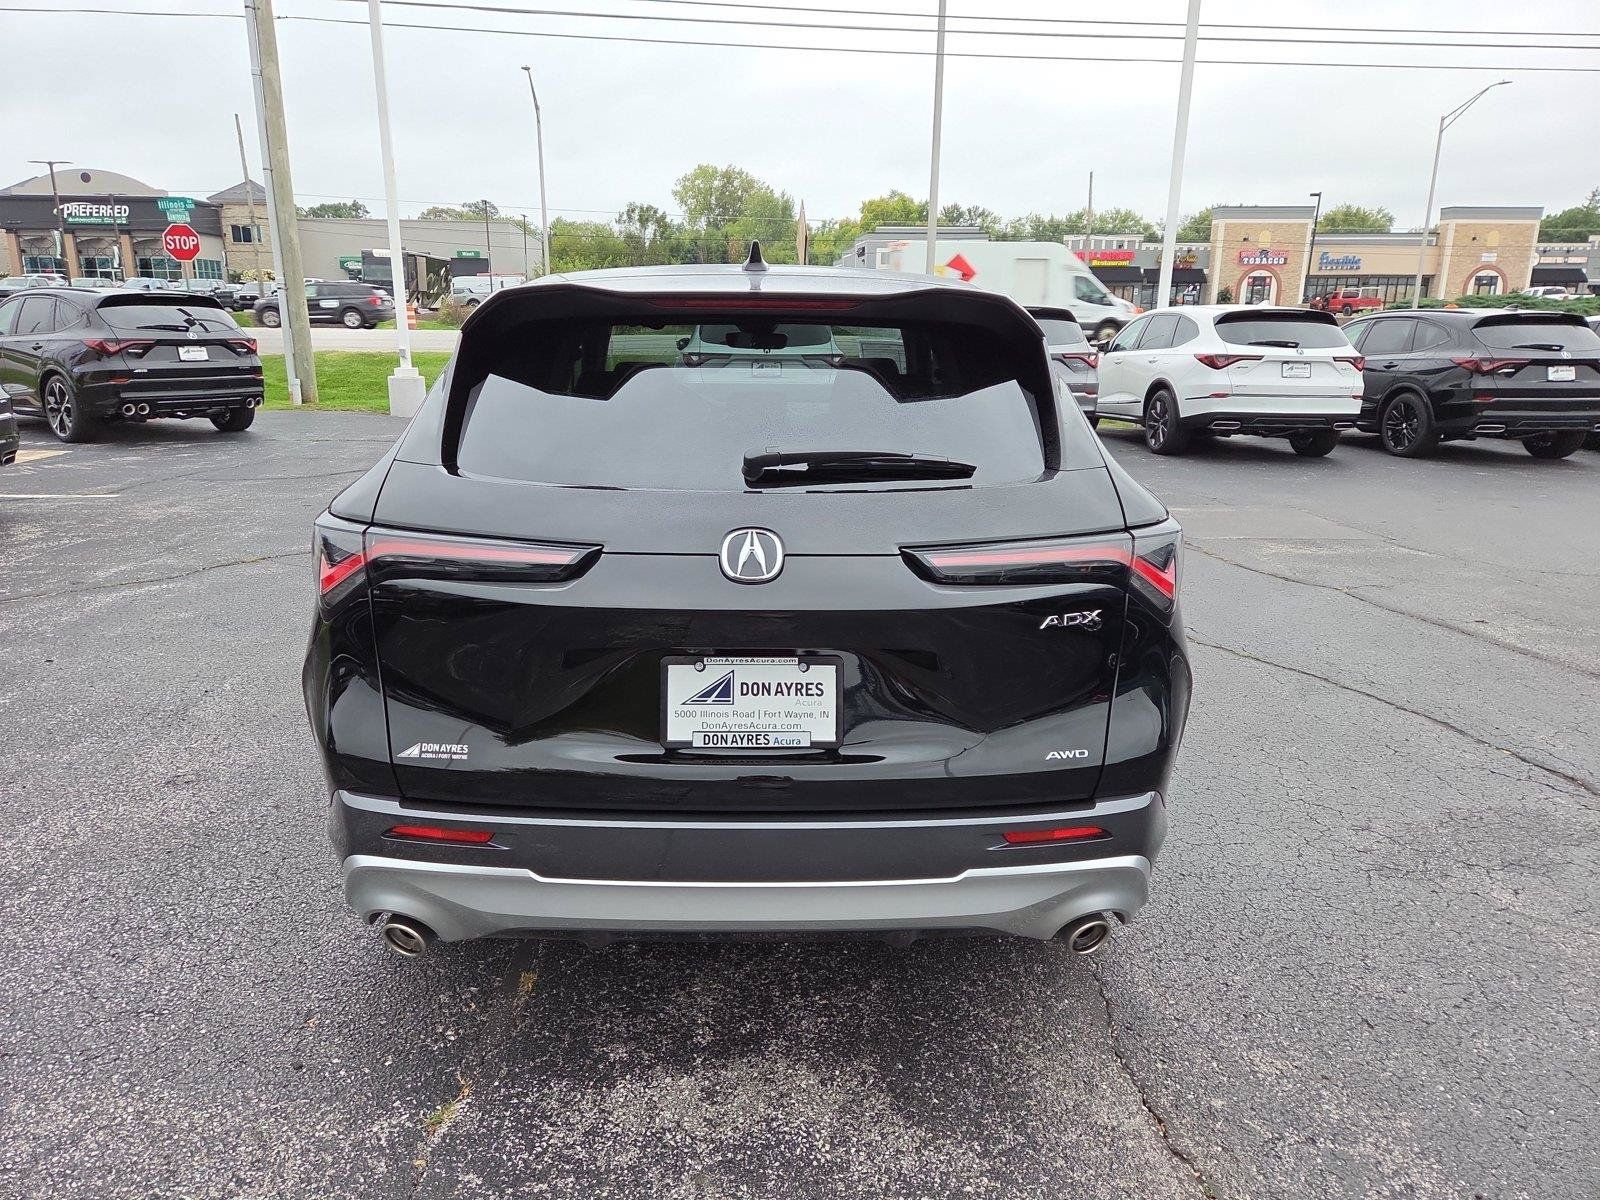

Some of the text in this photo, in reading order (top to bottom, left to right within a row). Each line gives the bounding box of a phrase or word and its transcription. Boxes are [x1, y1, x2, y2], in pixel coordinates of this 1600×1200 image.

[63, 203, 129, 218] PREFERRED
[158, 200, 185, 210] Illinois
[166, 235, 198, 250] STOP
[1092, 259, 1130, 267] Restaurant
[1039, 609, 1103, 630] ADX
[740, 681, 825, 697] DON AYRES
[795, 698, 823, 707] Acura
[674, 709, 830, 720] 5000 Illinois Road Fort Wayne, IN
[701, 721, 802, 732] DonAyresAcura.com
[703, 733, 802, 746] DON AYRES Acura
[421, 743, 469, 753] DON AYRES
[1045, 749, 1089, 760] AWD
